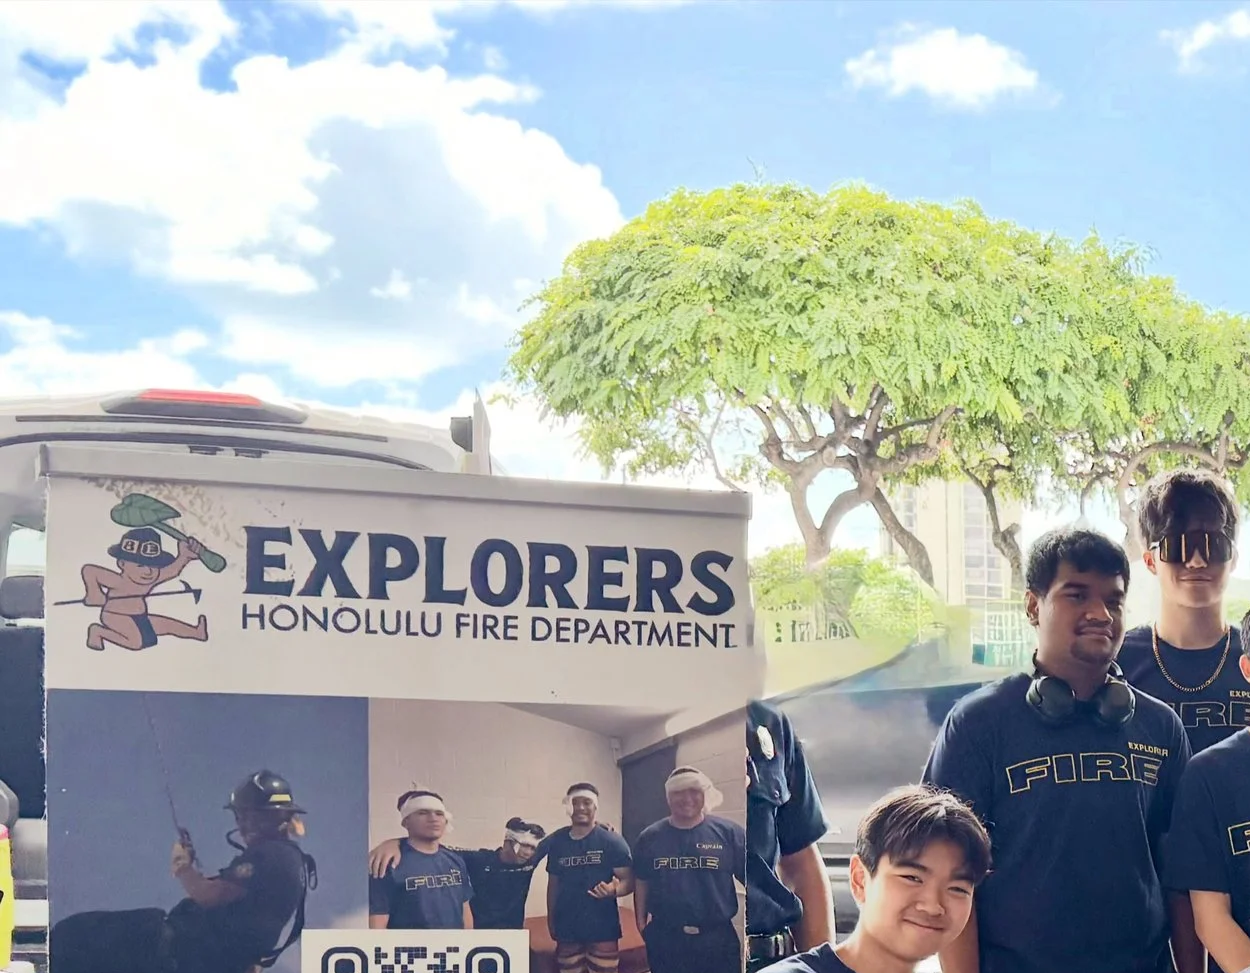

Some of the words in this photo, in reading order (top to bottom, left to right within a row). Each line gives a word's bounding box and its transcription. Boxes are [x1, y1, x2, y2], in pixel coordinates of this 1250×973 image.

[242, 526, 735, 616] EXPLORERS
[242, 603, 442, 638] HONOLULU
[455, 612, 518, 641] FIRE
[531, 616, 737, 648] DEPARTMENT
[1006, 751, 1162, 794] FIRE
[653, 856, 720, 869] FIRE
